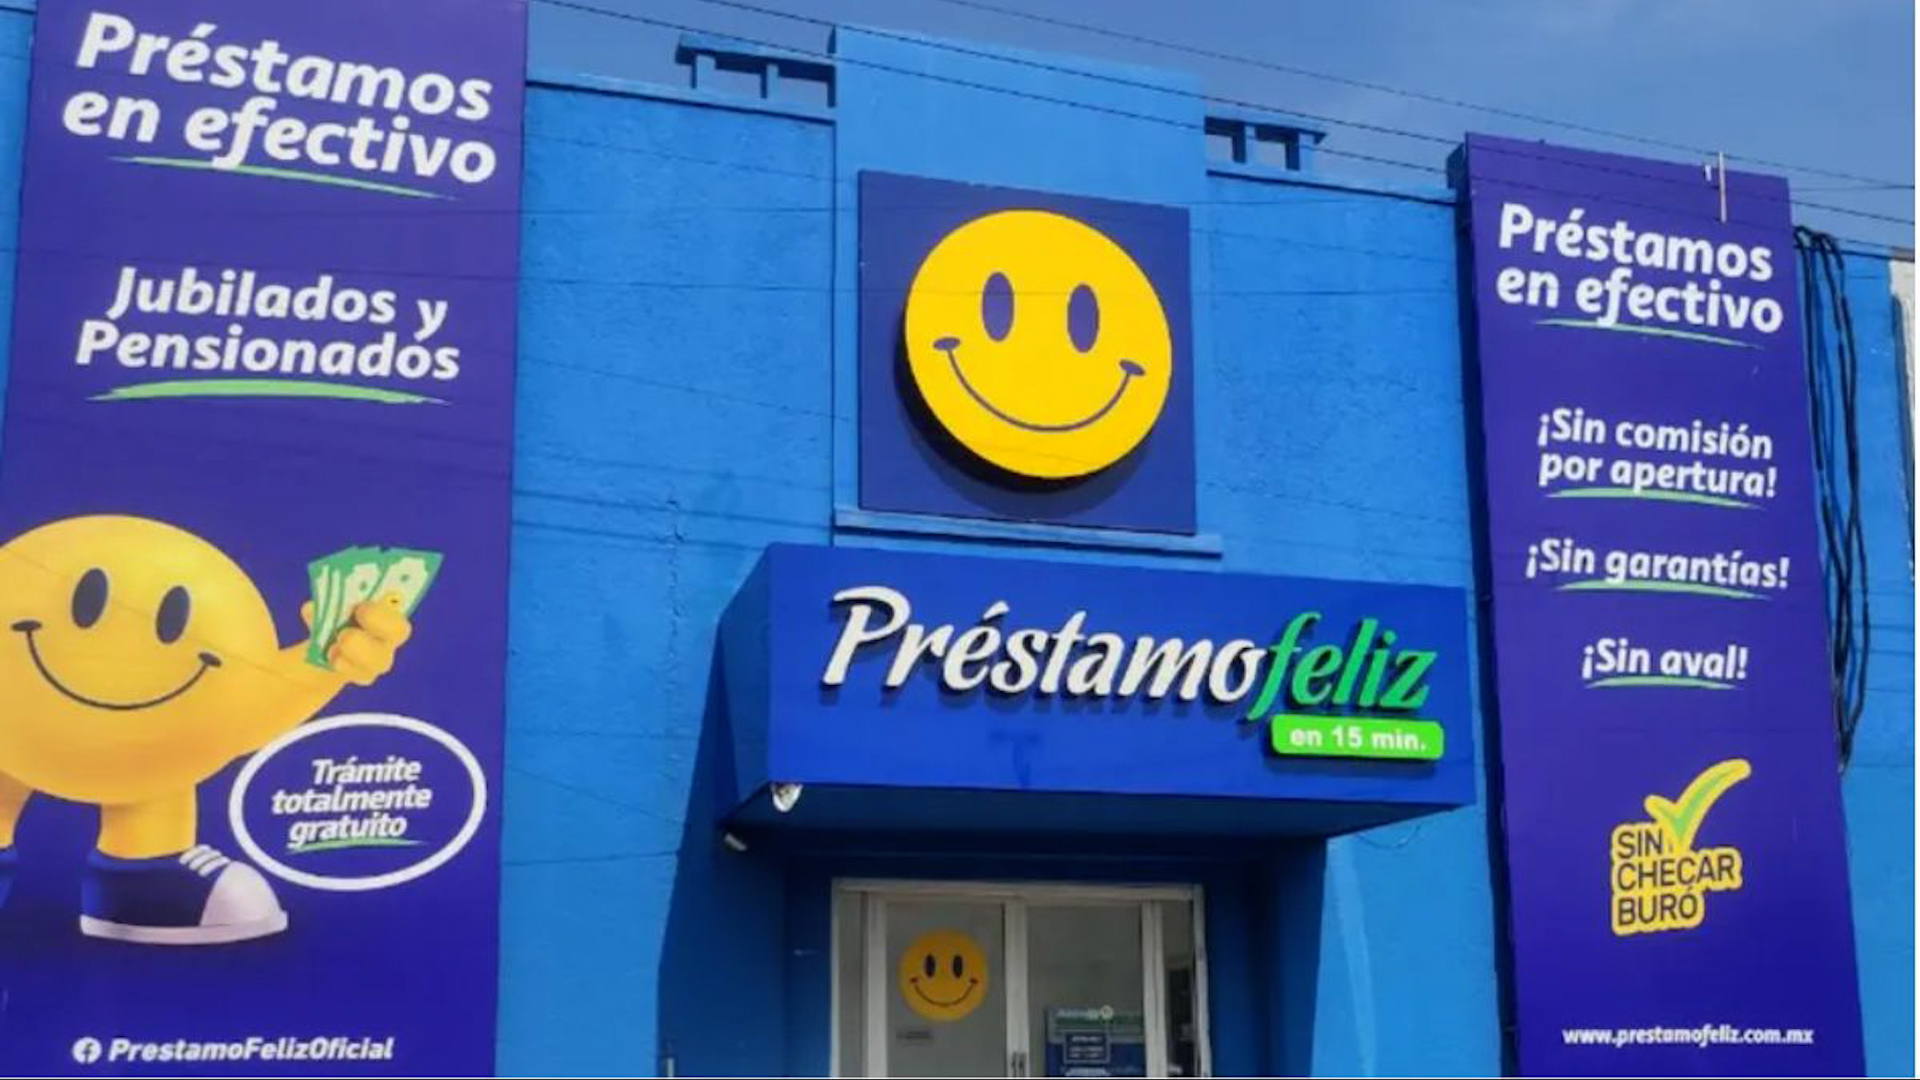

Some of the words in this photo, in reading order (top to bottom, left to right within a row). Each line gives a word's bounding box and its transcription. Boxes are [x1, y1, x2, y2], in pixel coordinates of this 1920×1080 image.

[77, 11, 494, 121] Préstamos
[62, 89, 161, 143] en
[184, 97, 497, 184] efectivo
[1499, 202, 1773, 282] Préstamos
[106, 265, 398, 324] Jubilados
[413, 298, 448, 341] y
[1496, 265, 1560, 308] en
[1575, 267, 1783, 333] efectivo
[75, 319, 461, 380] Pensionados
[1537, 408, 1606, 447] ¡Sin
[1615, 419, 1773, 460] comisión
[1538, 452, 1603, 487] por
[1610, 458, 1778, 498] apertura!
[1526, 538, 1595, 579] ¡Sin
[1605, 551, 1790, 589] garantías!
[1582, 637, 1649, 680] ¡Sin
[1660, 645, 1748, 680] aval!
[1289, 728, 1322, 748] en
[1331, 726, 1363, 749] 15
[1371, 727, 1427, 752] min.
[311, 756, 422, 785] Trámite
[271, 783, 433, 815] totalmente
[287, 812, 408, 849] gratuito
[1617, 829, 1663, 860] SIN
[1617, 853, 1736, 891] CHECAR
[1618, 887, 1699, 927] BURÓ
[108, 1036, 395, 1063] PrestamoFelizOficial
[1562, 1024, 1815, 1049] www.prestamofeliz.com.mx
